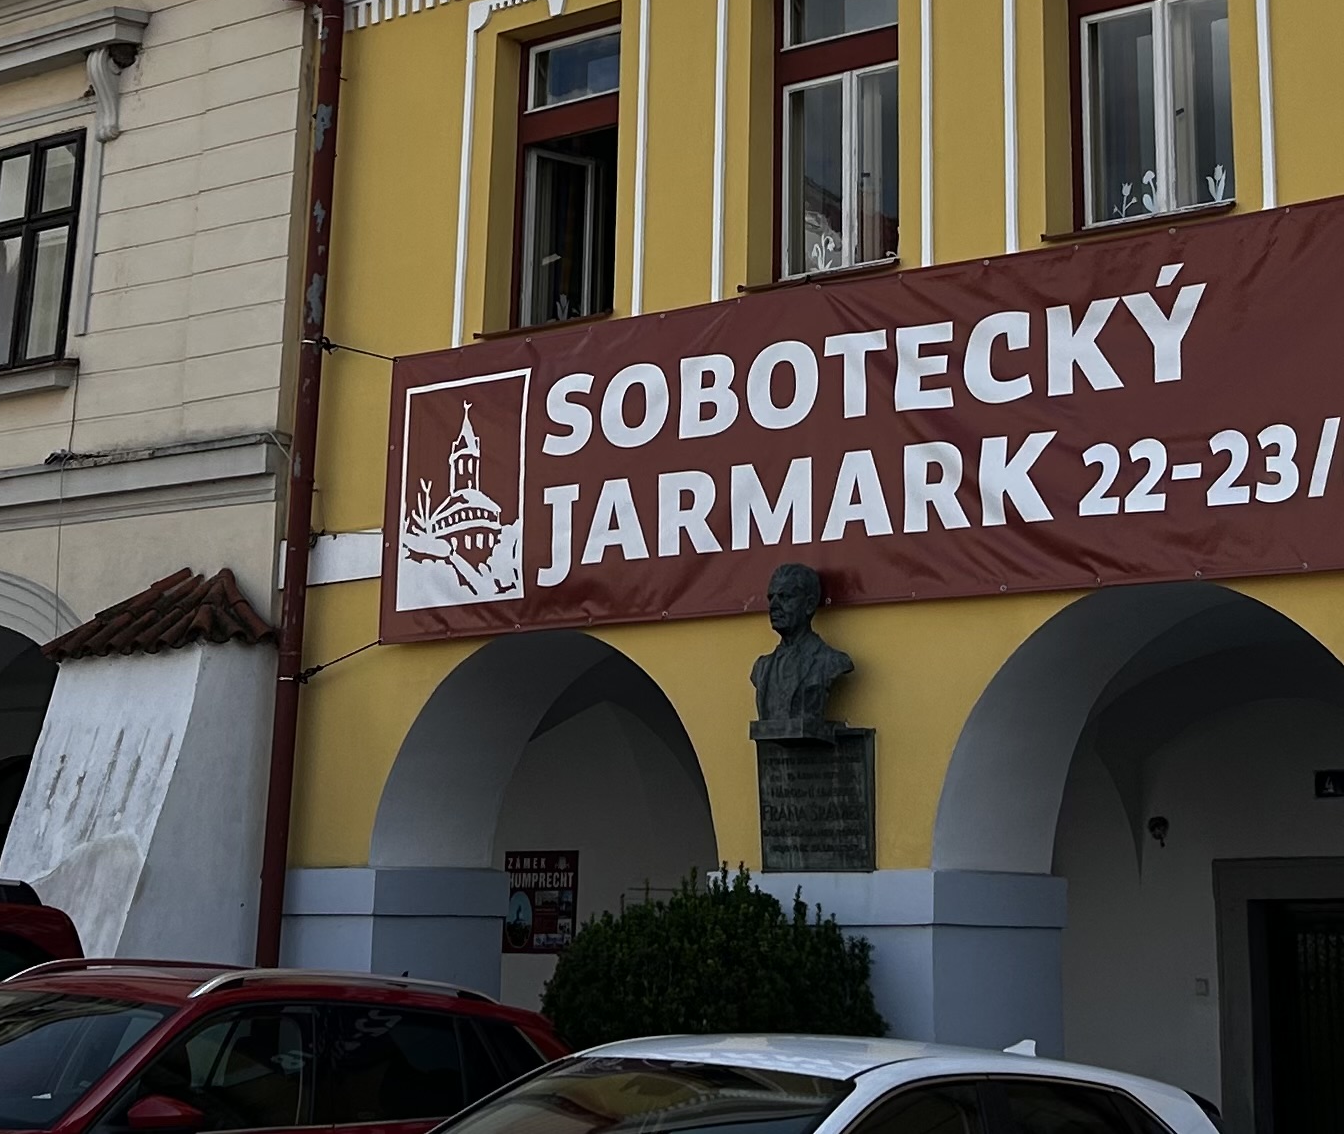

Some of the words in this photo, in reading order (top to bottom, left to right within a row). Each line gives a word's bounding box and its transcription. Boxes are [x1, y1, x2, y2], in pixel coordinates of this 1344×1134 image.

[542, 263, 1207, 456] SOBOTECKÝ
[537, 431, 1058, 587] JARMARK
[508, 855, 546, 869] ZÁMEK
[510, 872, 574, 888] HUMPRECHT
